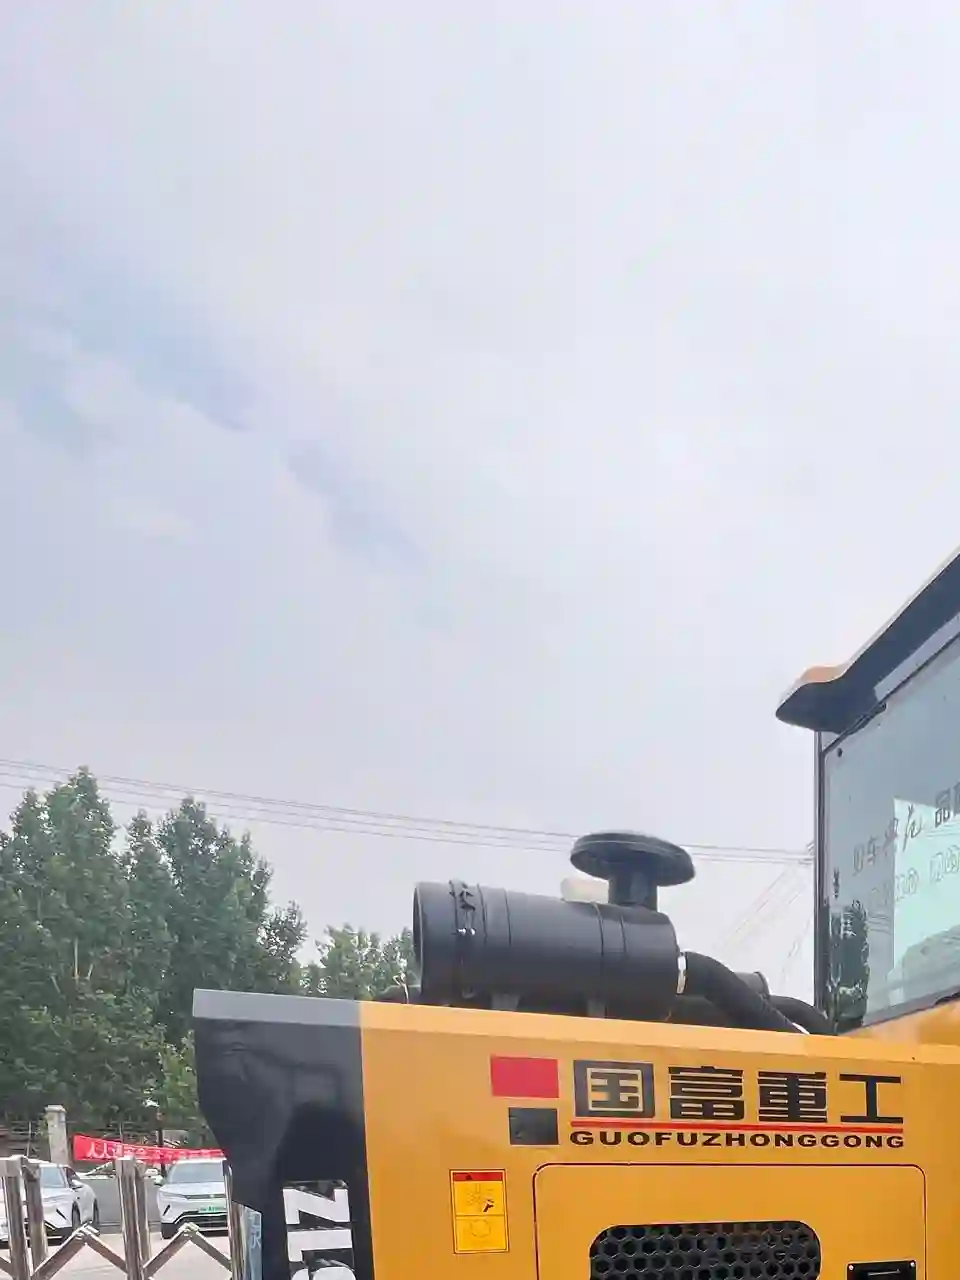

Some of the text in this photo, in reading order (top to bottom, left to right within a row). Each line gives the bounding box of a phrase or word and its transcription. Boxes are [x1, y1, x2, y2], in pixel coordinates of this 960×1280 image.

[573, 1060, 904, 1124] 国富重工
[570, 1130, 904, 1149] GUOFUZHONGGONG
